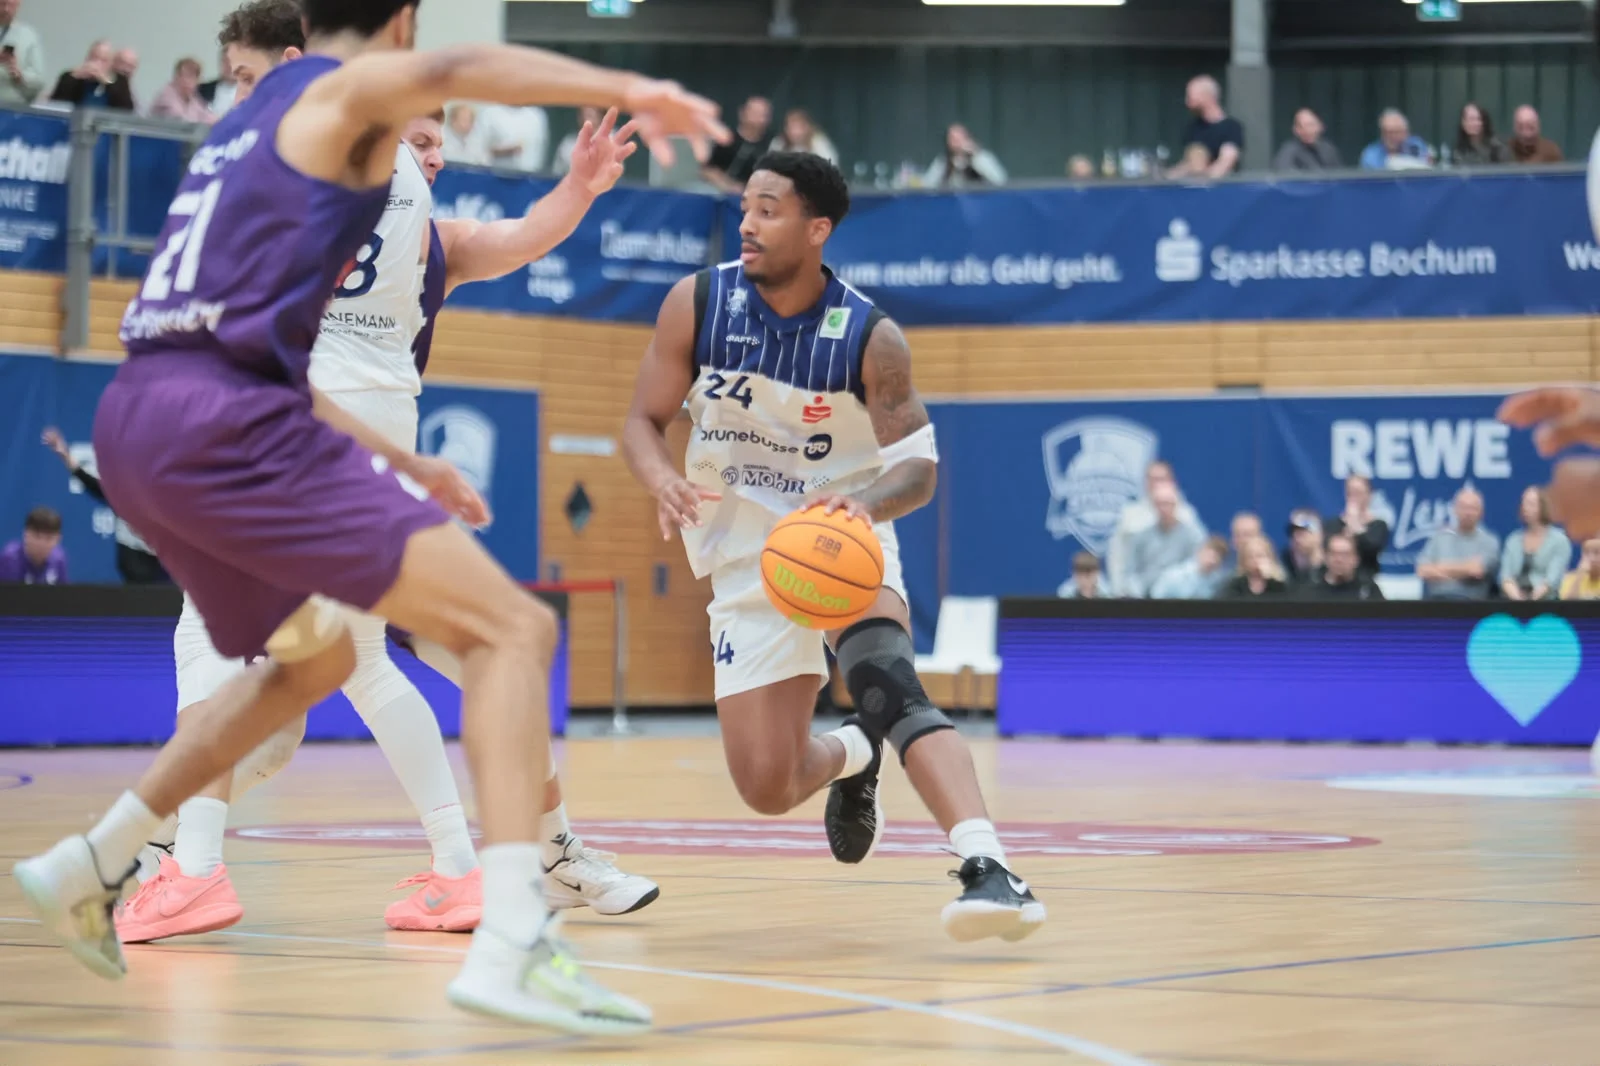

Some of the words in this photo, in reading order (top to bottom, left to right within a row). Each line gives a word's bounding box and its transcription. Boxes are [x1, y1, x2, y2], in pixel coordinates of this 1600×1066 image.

[141, 178, 223, 301] 21
[883, 256, 948, 287] mehr
[950, 254, 991, 286] als
[992, 253, 1051, 285] Geld
[1053, 254, 1123, 289] geht.
[1210, 245, 1365, 287] Sparkasse
[1369, 241, 1496, 277] Bochum
[726, 334, 752, 343] CRAFT
[704, 372, 752, 410] 24
[1331, 419, 1512, 480] REWE
[815, 535, 842, 554] FIBA
[773, 564, 851, 610] Wilson
